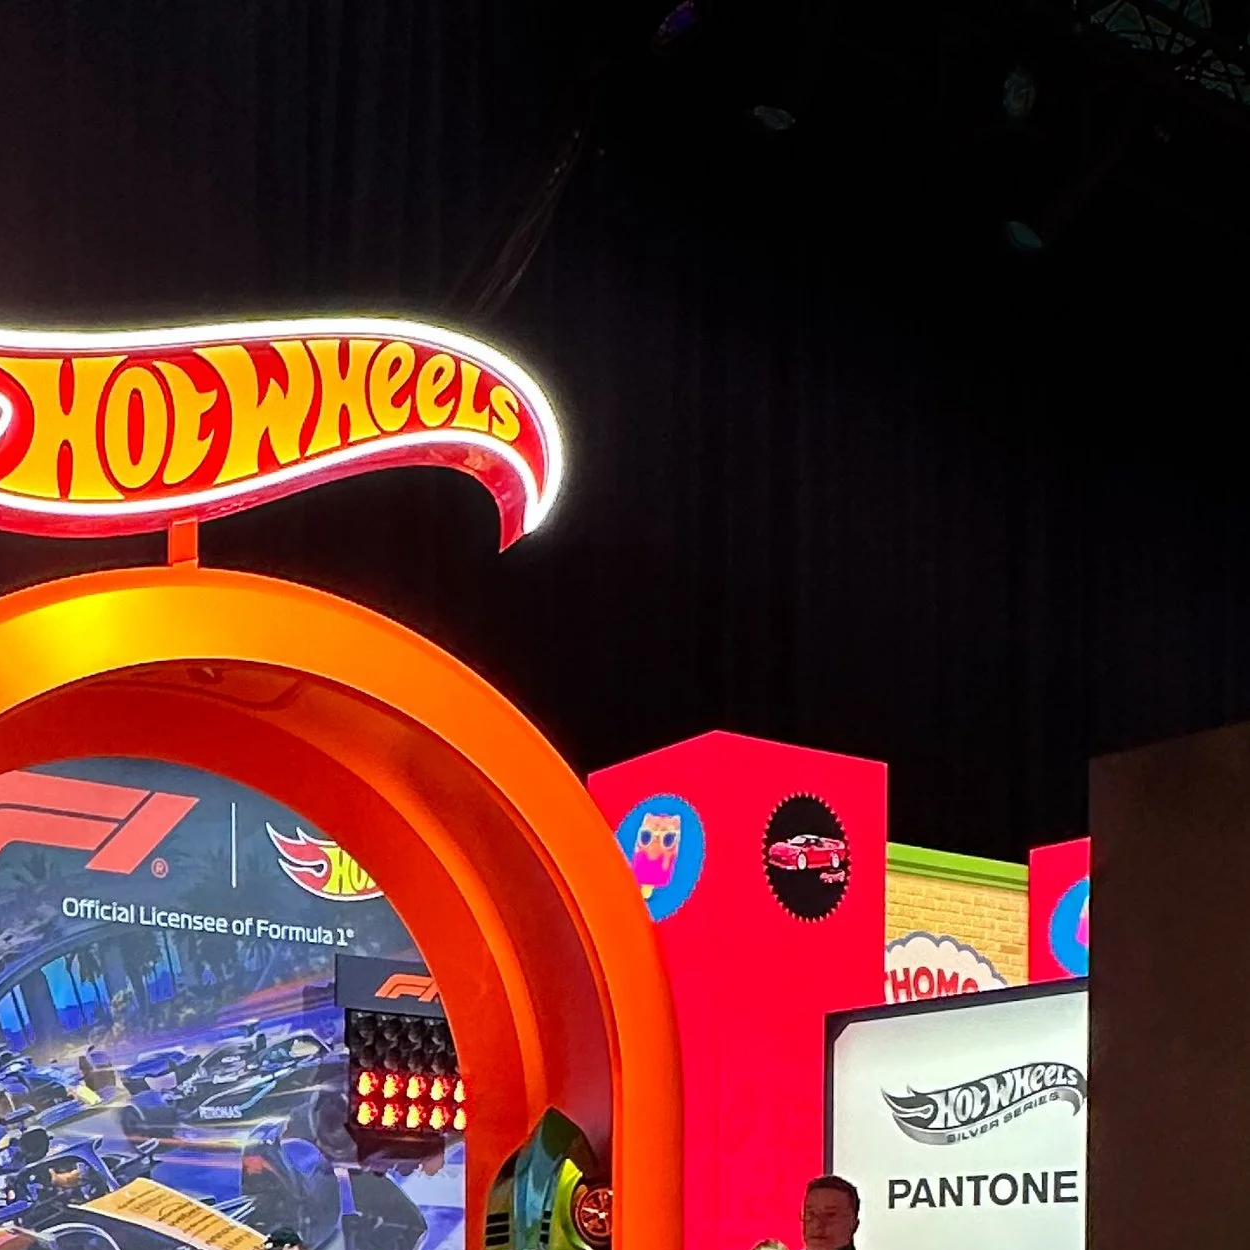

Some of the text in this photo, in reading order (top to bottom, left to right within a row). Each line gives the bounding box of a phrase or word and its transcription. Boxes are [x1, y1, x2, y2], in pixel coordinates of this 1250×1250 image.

[319, 847, 376, 895] HO
[61, 896, 135, 924] Official
[139, 906, 229, 934] Licensee
[231, 917, 253, 936] of
[256, 919, 333, 945] Formula
[946, 1091, 1060, 1144] SILVER SERIES
[887, 1170, 1079, 1210] PANTONE
